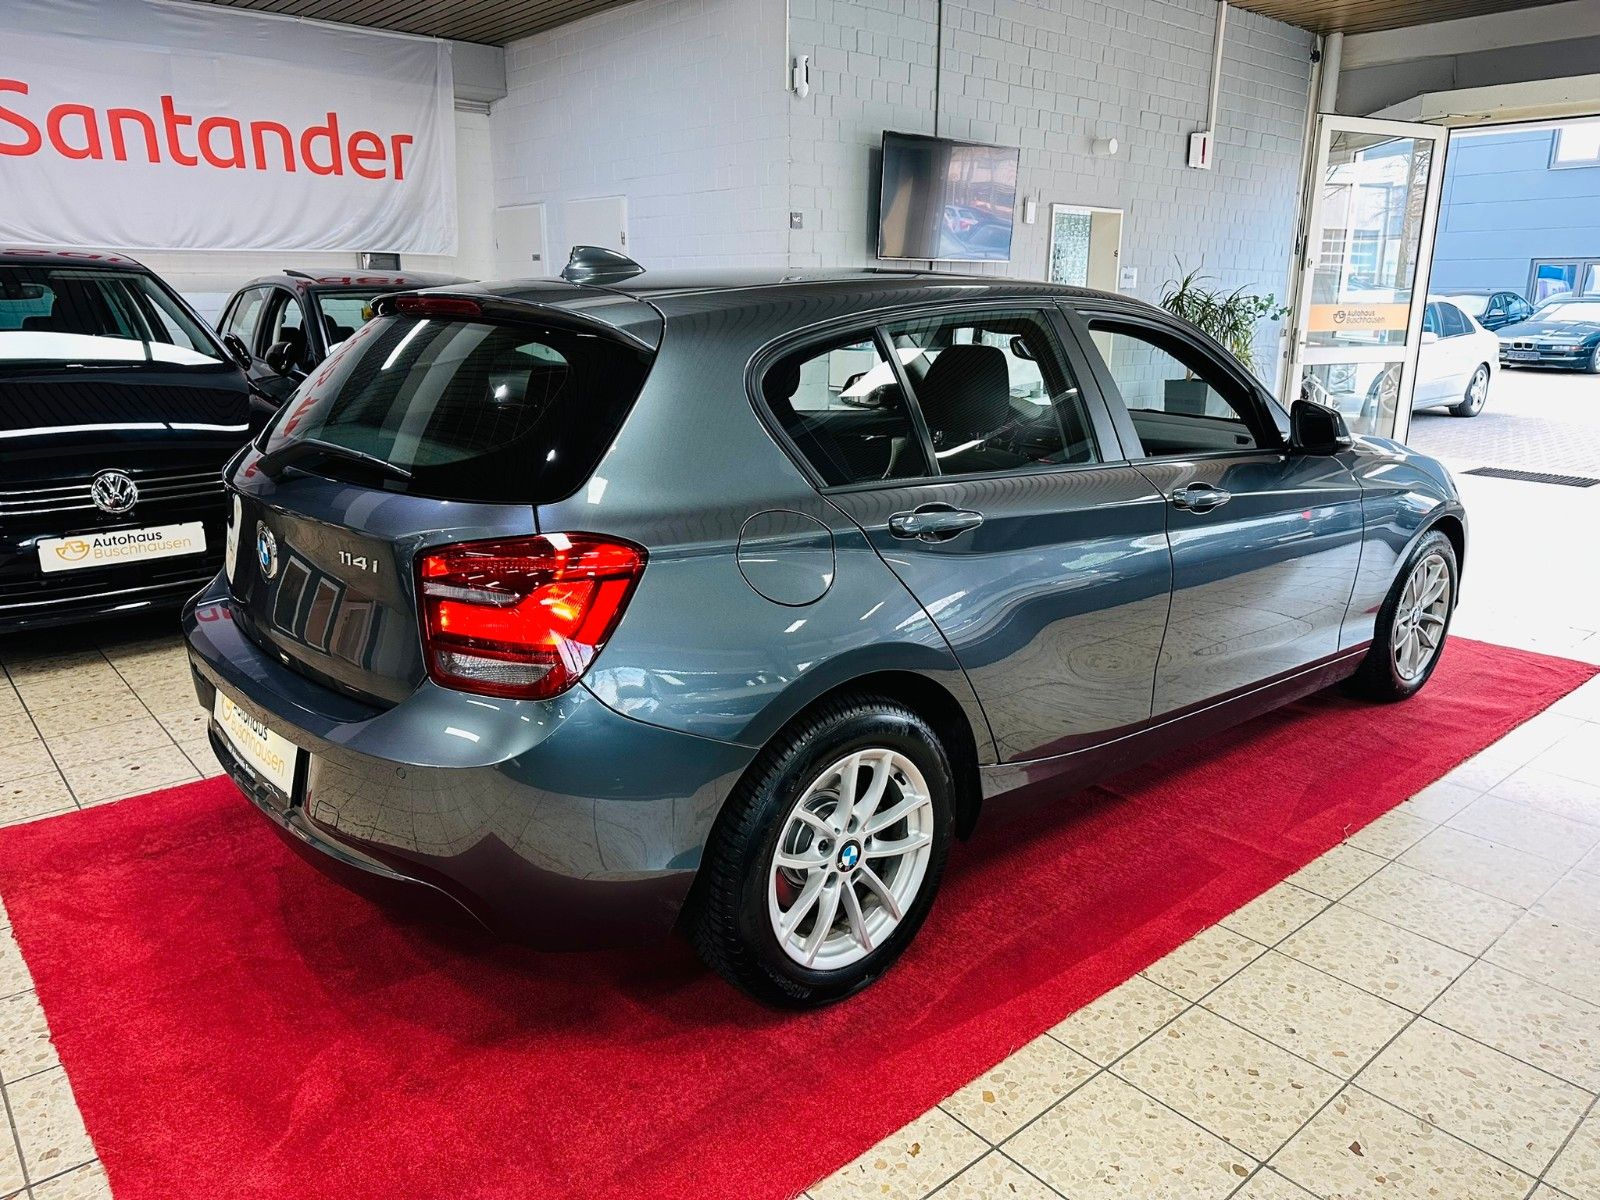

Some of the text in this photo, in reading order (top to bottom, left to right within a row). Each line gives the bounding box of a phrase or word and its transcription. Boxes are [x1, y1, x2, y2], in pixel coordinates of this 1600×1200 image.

[0, 79, 414, 181] Santander
[93, 531, 162, 548] Autohaus
[94, 537, 192, 559] Buschhausen
